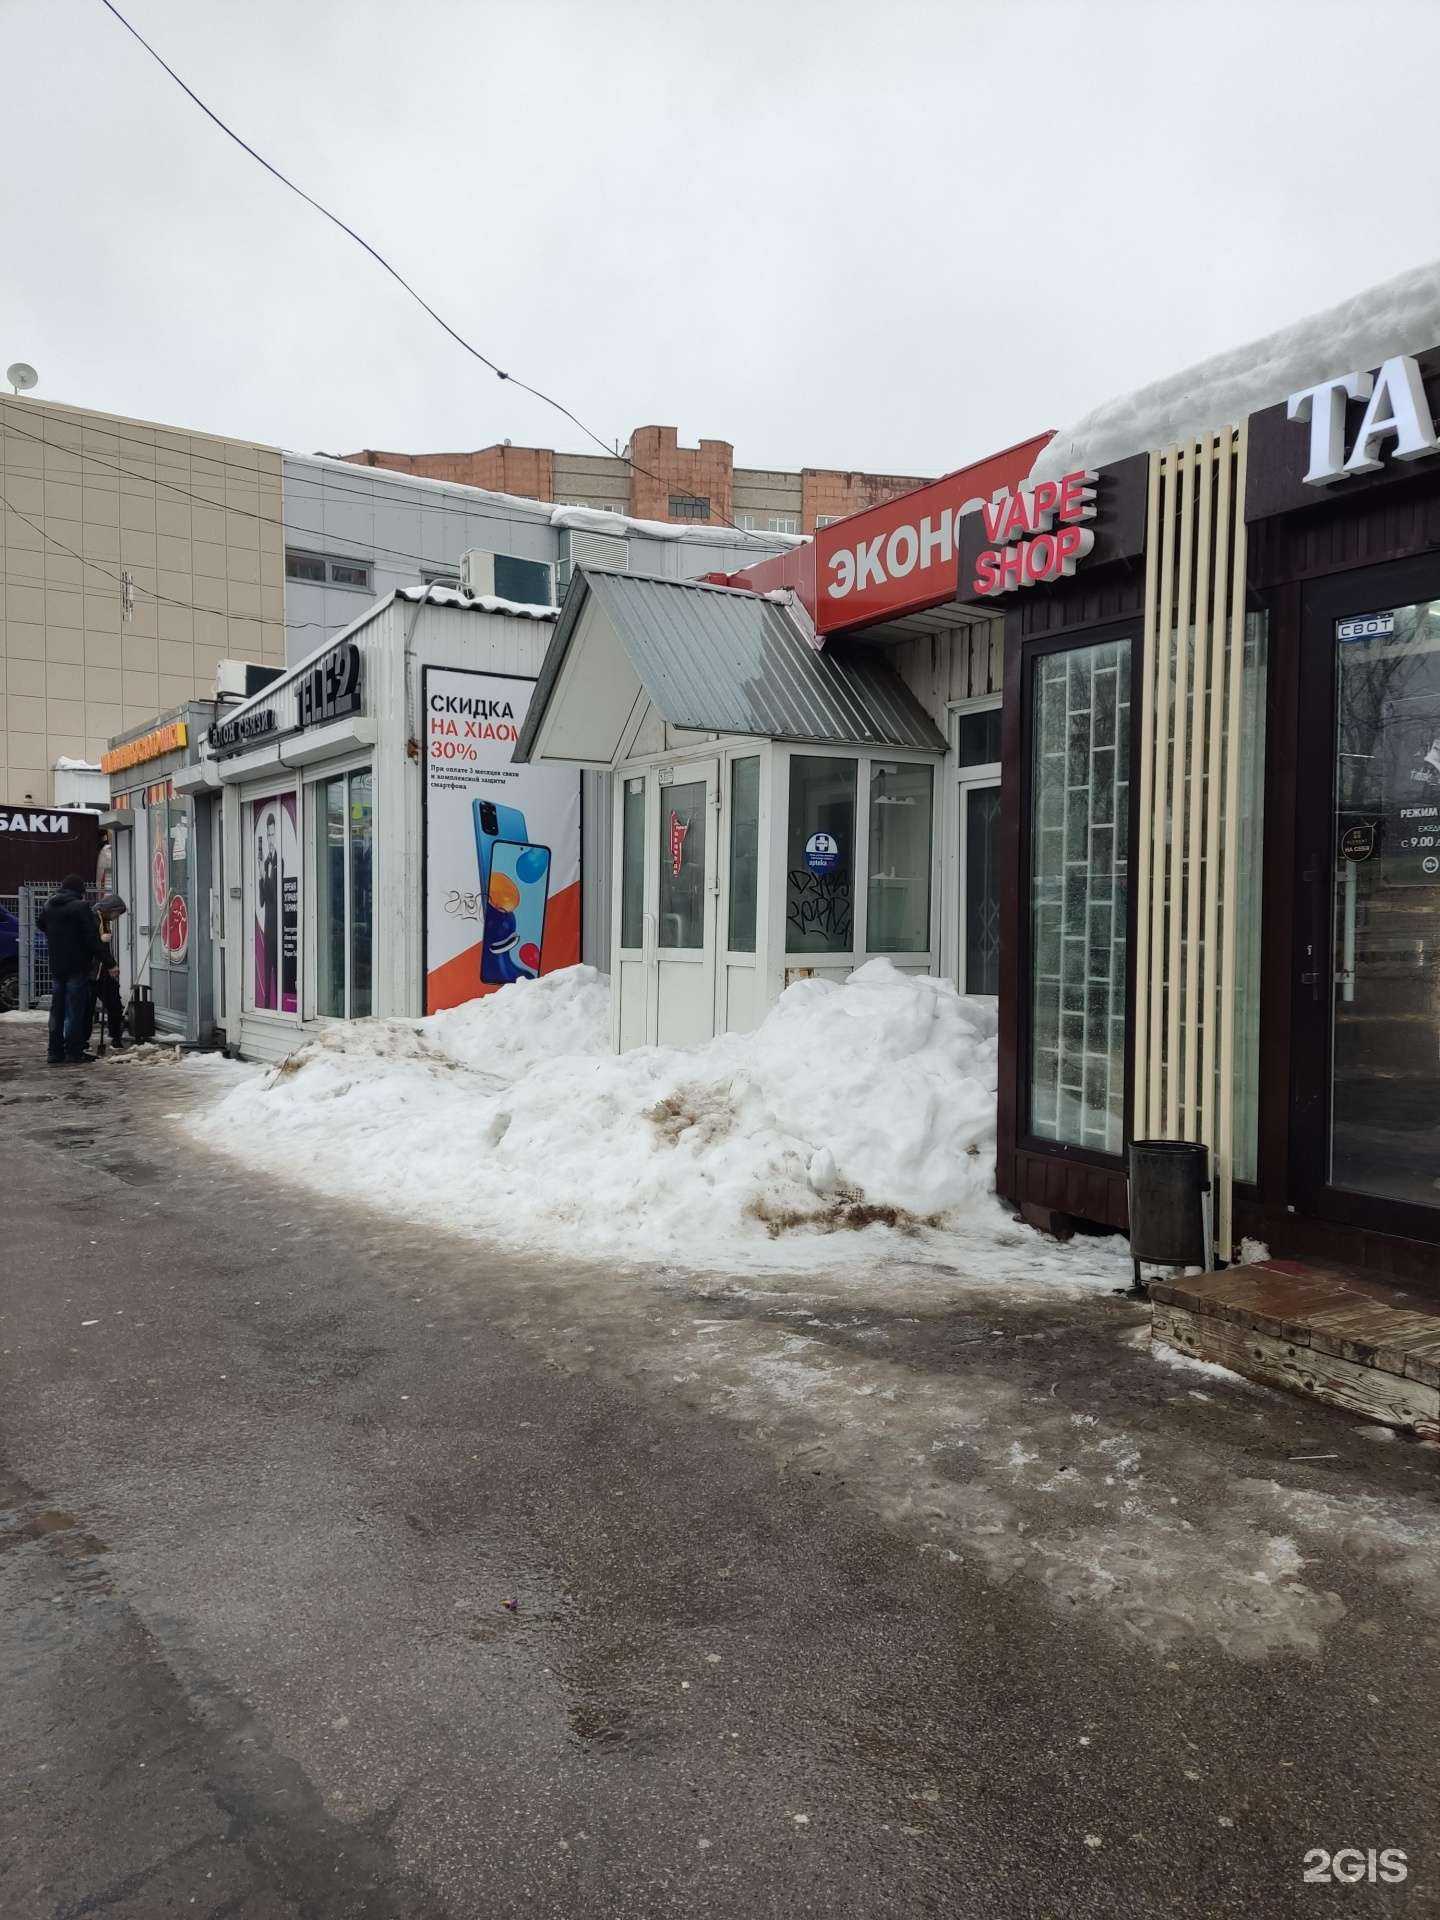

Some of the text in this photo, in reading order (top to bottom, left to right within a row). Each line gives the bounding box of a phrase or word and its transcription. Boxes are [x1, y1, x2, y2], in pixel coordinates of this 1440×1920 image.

[982, 470, 1098, 545] VAPE
[827, 487, 1012, 600] ЭКОН
[972, 526, 1095, 597] SHOP
[294, 643, 362, 727] TELE2
[430, 694, 514, 720] СКИДКА
[431, 717, 459, 737] НА
[431, 740, 478, 761] 30%
[430, 764, 444, 773] При
[430, 782, 467, 790] смартфона
[1400, 806, 1439, 819] РЕЖИМ
[1410, 836, 1434, 848] 9.00
